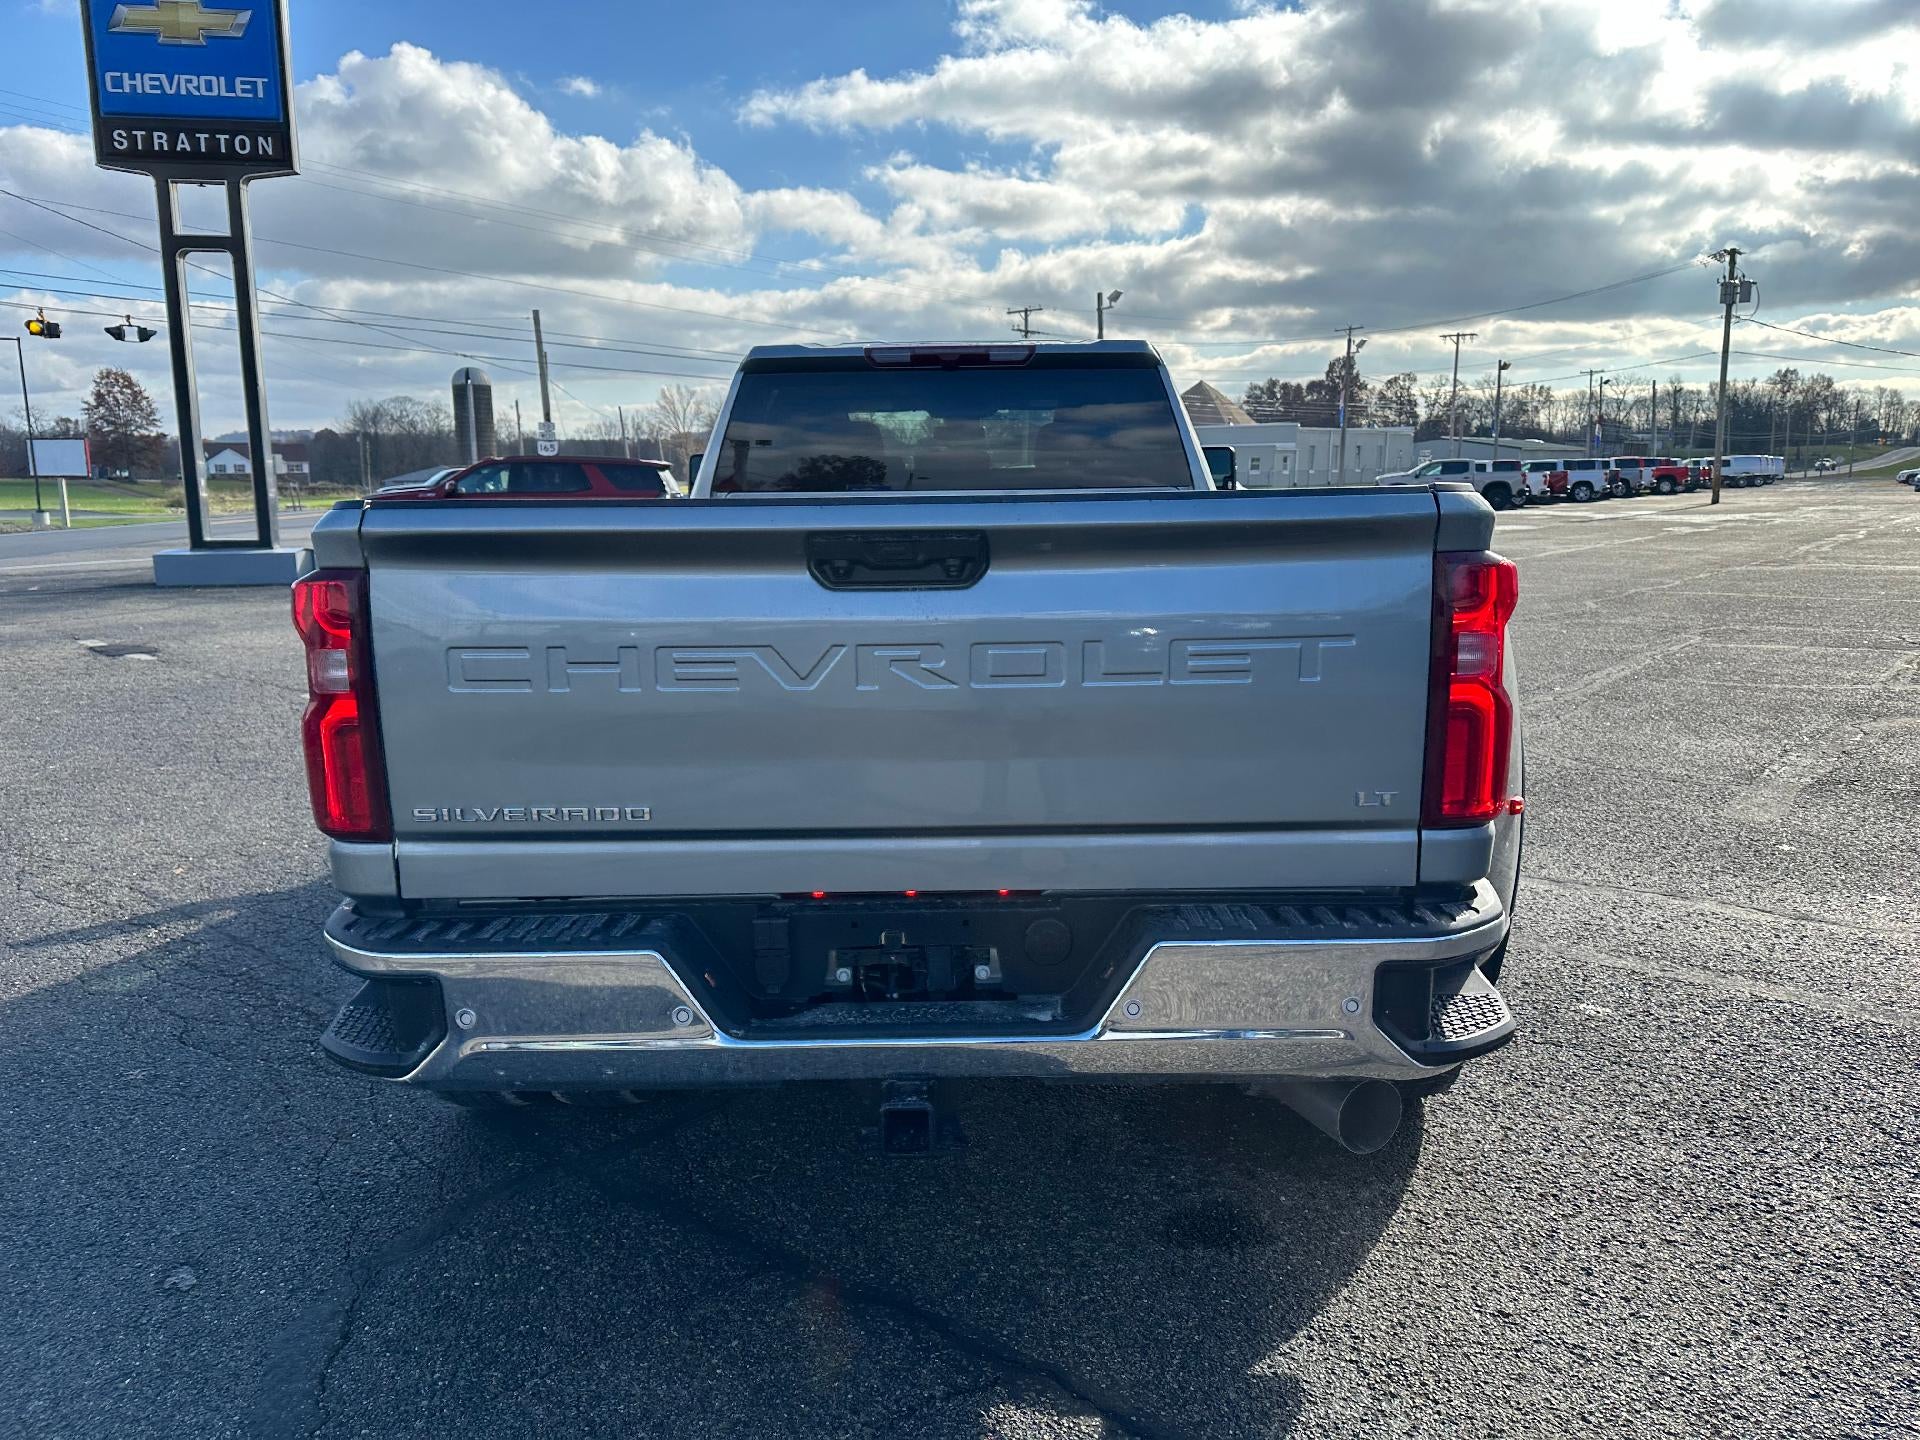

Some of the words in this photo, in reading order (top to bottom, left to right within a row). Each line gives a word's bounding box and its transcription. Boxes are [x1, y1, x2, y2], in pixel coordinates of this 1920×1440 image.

[104, 71, 269, 99] CHEVROLET
[112, 129, 273, 156] STRATTON
[540, 444, 556, 453] 165
[446, 634, 1356, 693] CHEVROLET
[1356, 791, 1399, 807] LT
[412, 807, 651, 823] SILVERADO
